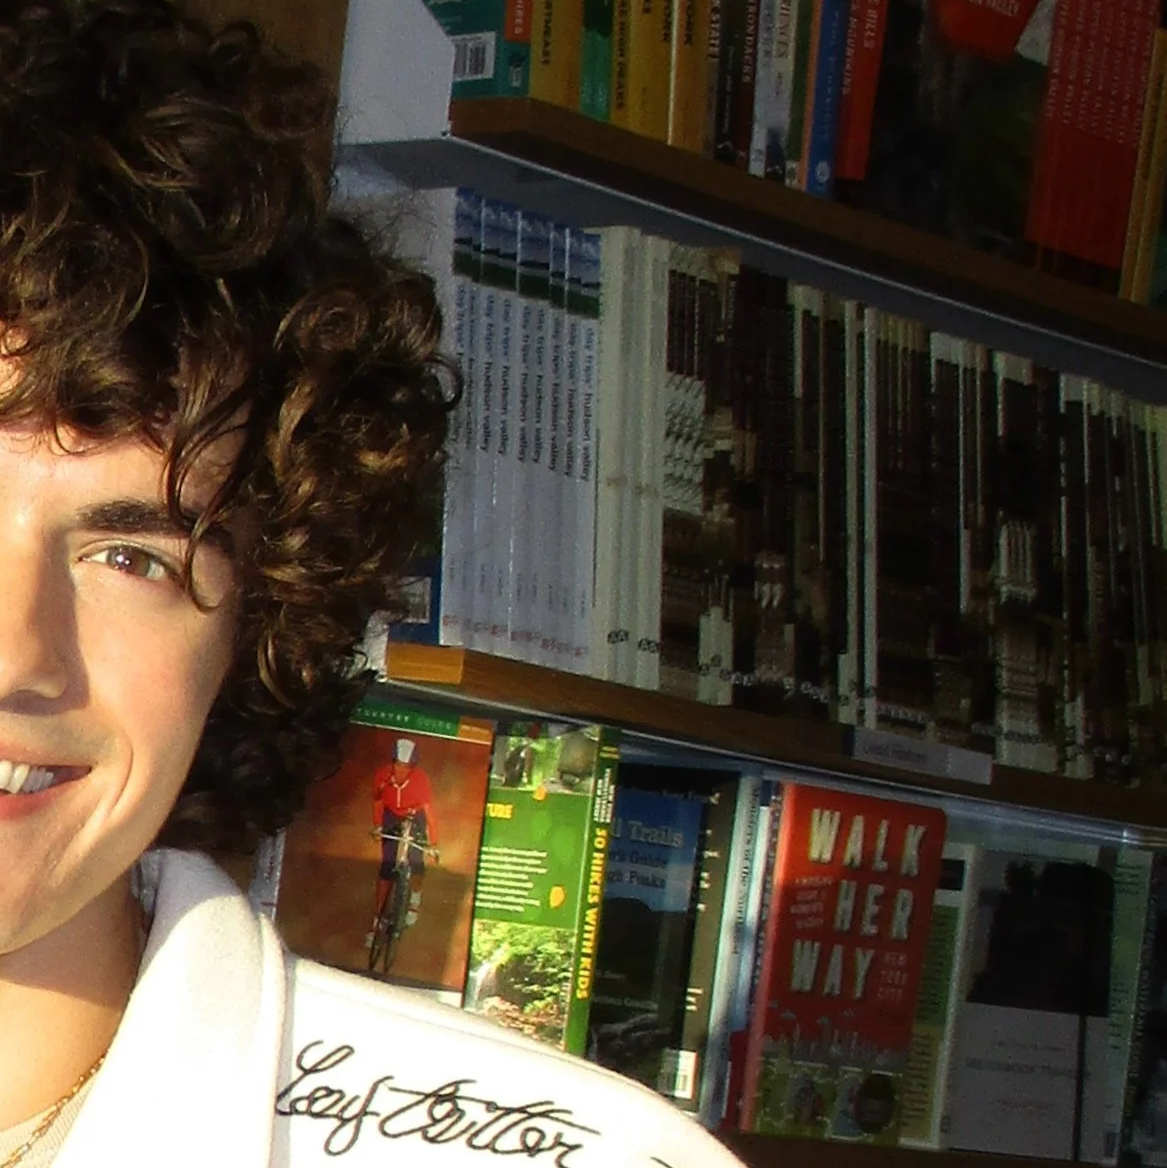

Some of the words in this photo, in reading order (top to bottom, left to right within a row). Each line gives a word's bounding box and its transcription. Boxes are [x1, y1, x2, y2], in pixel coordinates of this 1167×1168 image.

[593, 827, 610, 850] 50
[807, 806, 927, 878] WALK
[586, 852, 607, 905] HIKES
[739, 866, 751, 888] the
[580, 908, 603, 955] WITH
[833, 878, 916, 941] HER
[575, 955, 597, 1001] KIDS
[789, 939, 876, 1000] WAY
